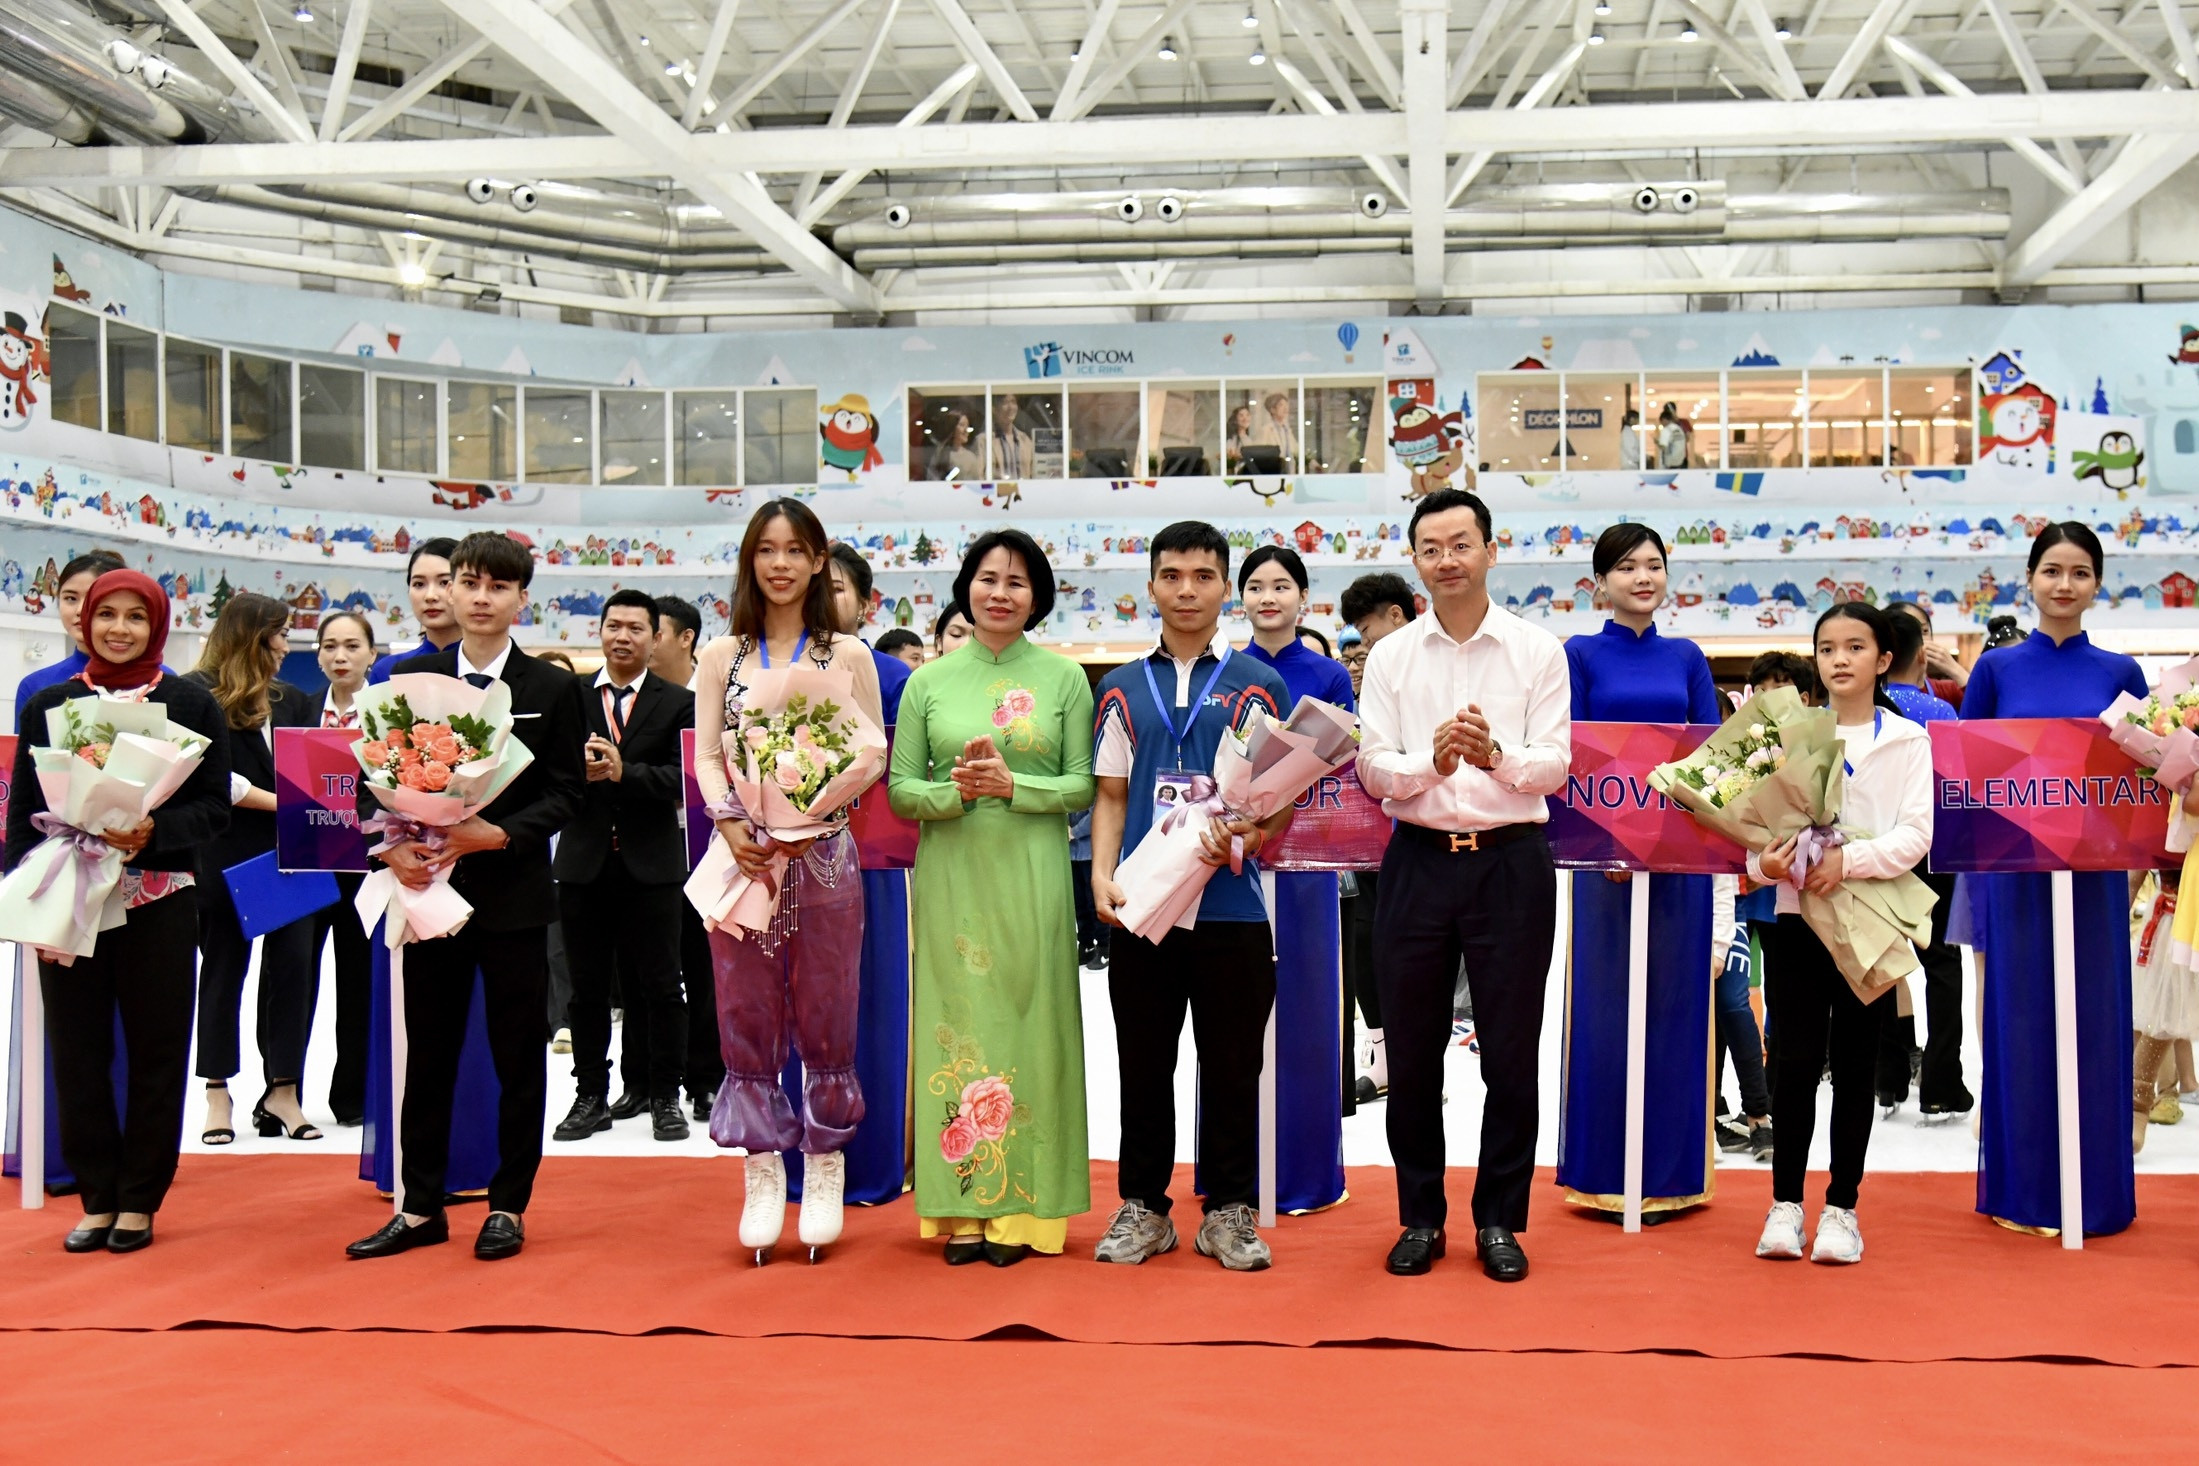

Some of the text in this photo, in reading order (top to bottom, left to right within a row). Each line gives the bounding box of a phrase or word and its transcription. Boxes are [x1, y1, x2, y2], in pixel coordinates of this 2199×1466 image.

[1063, 350, 1134, 364] VINCOM
[1077, 365, 1124, 375] ICE RINK
[1566, 773, 1691, 813] NOVI
